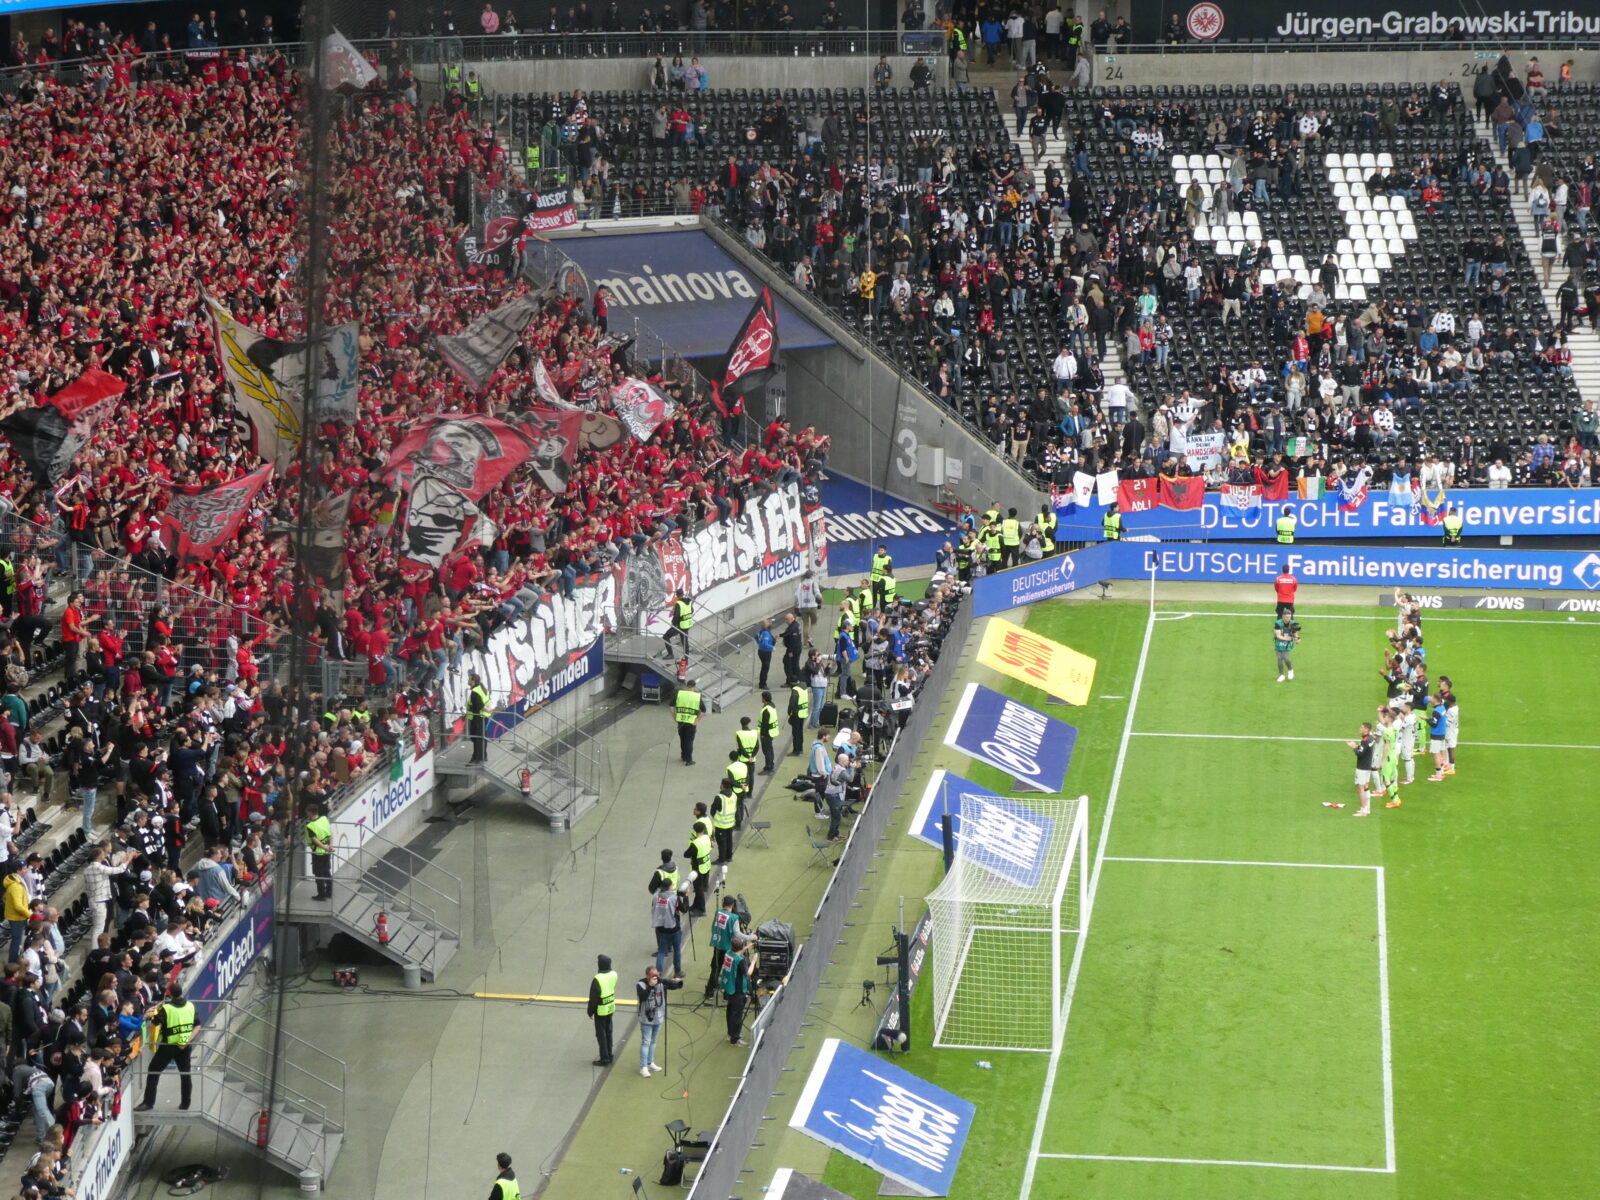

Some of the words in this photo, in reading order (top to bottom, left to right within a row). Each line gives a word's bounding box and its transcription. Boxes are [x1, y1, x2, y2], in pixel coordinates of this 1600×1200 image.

[1105, 66, 1123, 80] 24
[1462, 63, 1479, 77] 24
[594, 264, 757, 307] mainova
[896, 429, 918, 478] 3
[1133, 480, 1147, 491] 21
[682, 482, 806, 597] MEISTER
[823, 506, 945, 543] ainova
[1012, 566, 1060, 592] DEUTSCHE
[1144, 551, 1278, 575] DEUTSCHE
[1287, 554, 1563, 586] Familienversicherung
[1012, 581, 1075, 605] Familienversicherung
[1486, 596, 1525, 610] DWS
[993, 699, 1049, 758] HYUNDAI
[371, 765, 412, 829] indeed
[215, 917, 255, 998] indeed
[823, 1069, 961, 1173] indeed
[95, 1127, 122, 1200] finden
